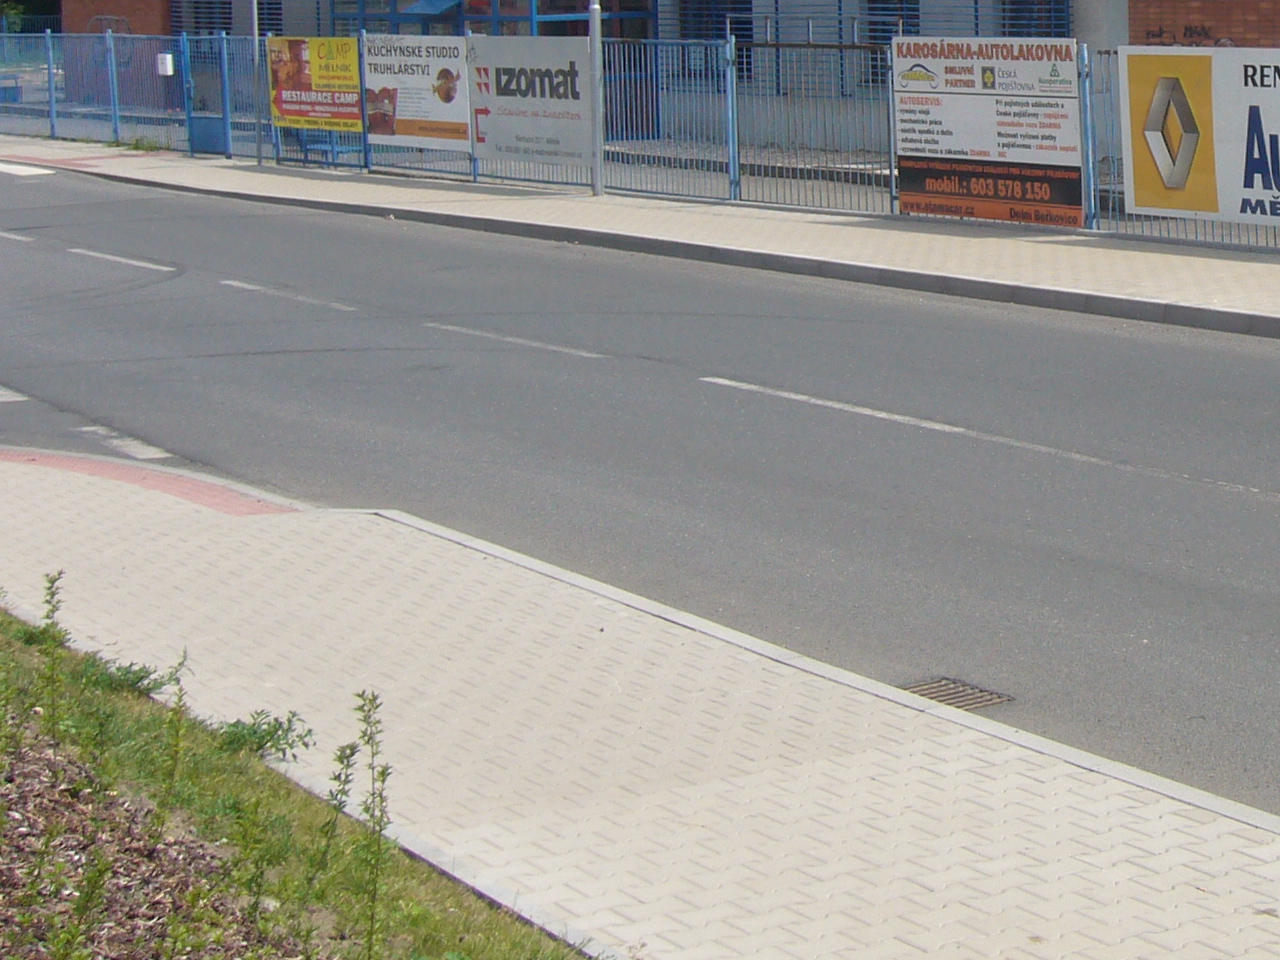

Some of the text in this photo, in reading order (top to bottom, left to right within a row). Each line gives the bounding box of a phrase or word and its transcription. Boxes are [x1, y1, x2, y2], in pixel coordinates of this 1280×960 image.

[425, 46, 460, 59] STUDIO
[282, 90, 358, 104] RESTAURACE CAMP
[970, 178, 994, 195] 603
[998, 179, 1022, 198] 578
[1025, 182, 1050, 201] 150
